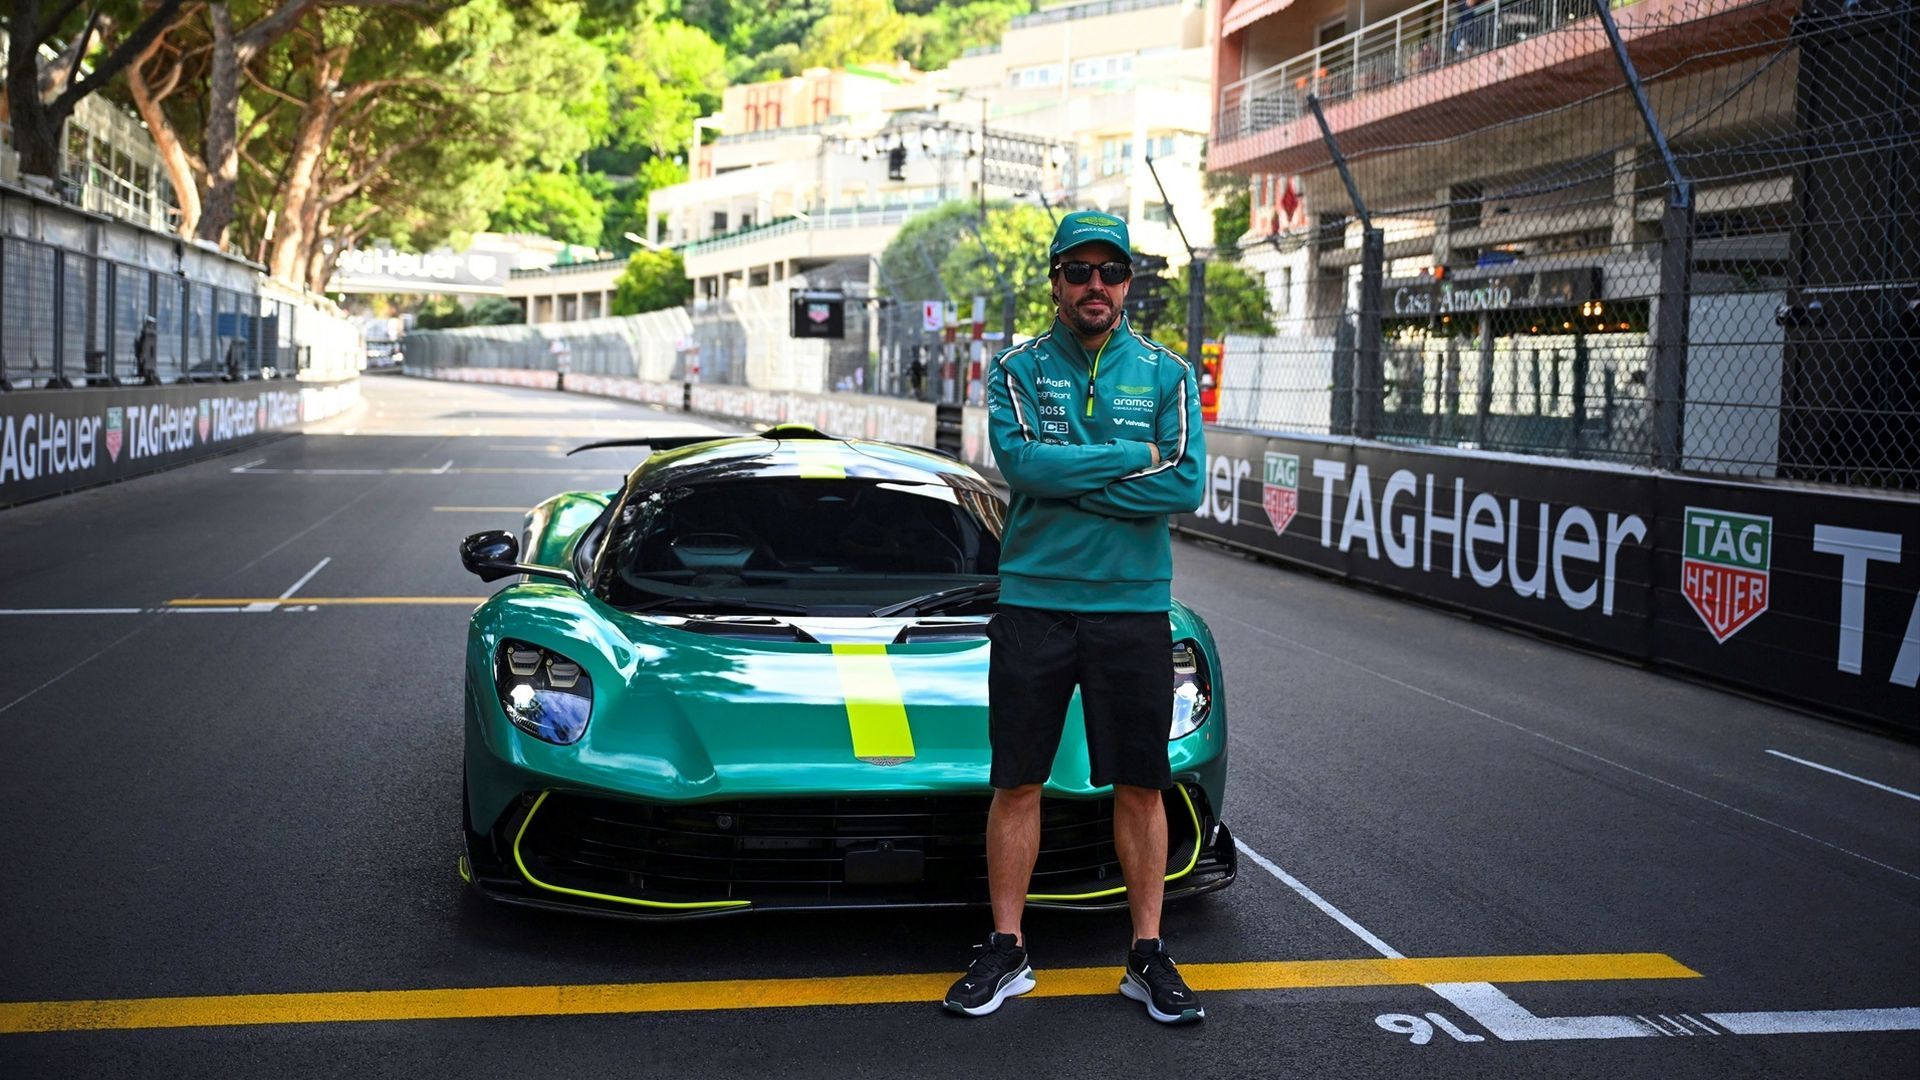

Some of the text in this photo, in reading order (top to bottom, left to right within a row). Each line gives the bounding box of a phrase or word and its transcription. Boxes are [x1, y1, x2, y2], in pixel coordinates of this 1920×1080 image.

[1394, 287, 1431, 314] Casa
[1037, 390, 1071, 400] ognizant
[1113, 398, 1154, 408] aramco
[1039, 405, 1066, 416] BOSS
[0, 412, 102, 484] AGHeuer
[1266, 458, 1296, 486] TAG
[1691, 516, 1762, 564] TAG
[1687, 565, 1763, 632] HEUER
